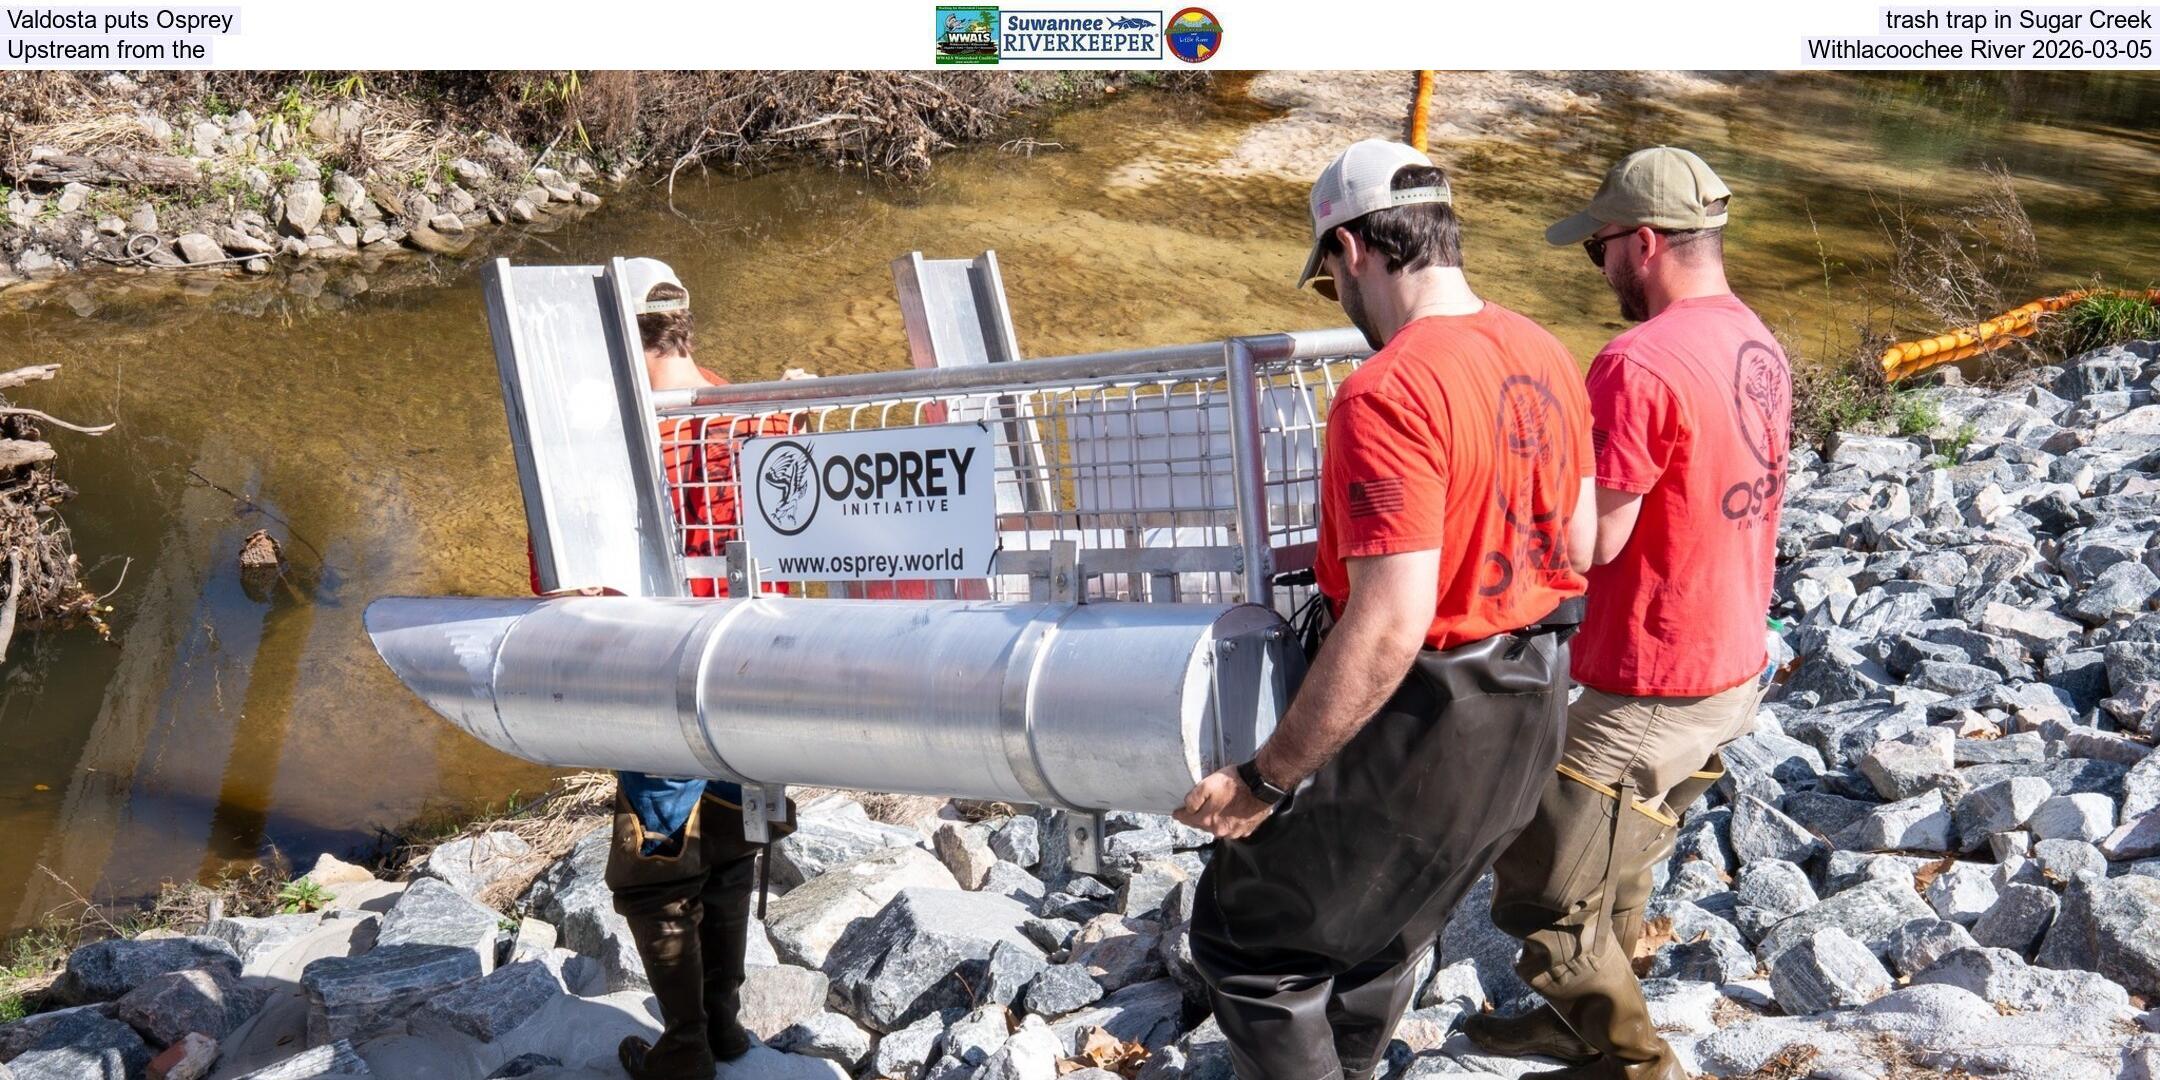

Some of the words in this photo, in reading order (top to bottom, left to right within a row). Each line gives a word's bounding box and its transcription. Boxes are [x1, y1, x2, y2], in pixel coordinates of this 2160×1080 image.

[823, 447, 976, 501] OSPREY
[843, 499, 949, 516] INITIATIVE
[778, 547, 964, 578] www.osprey.world
